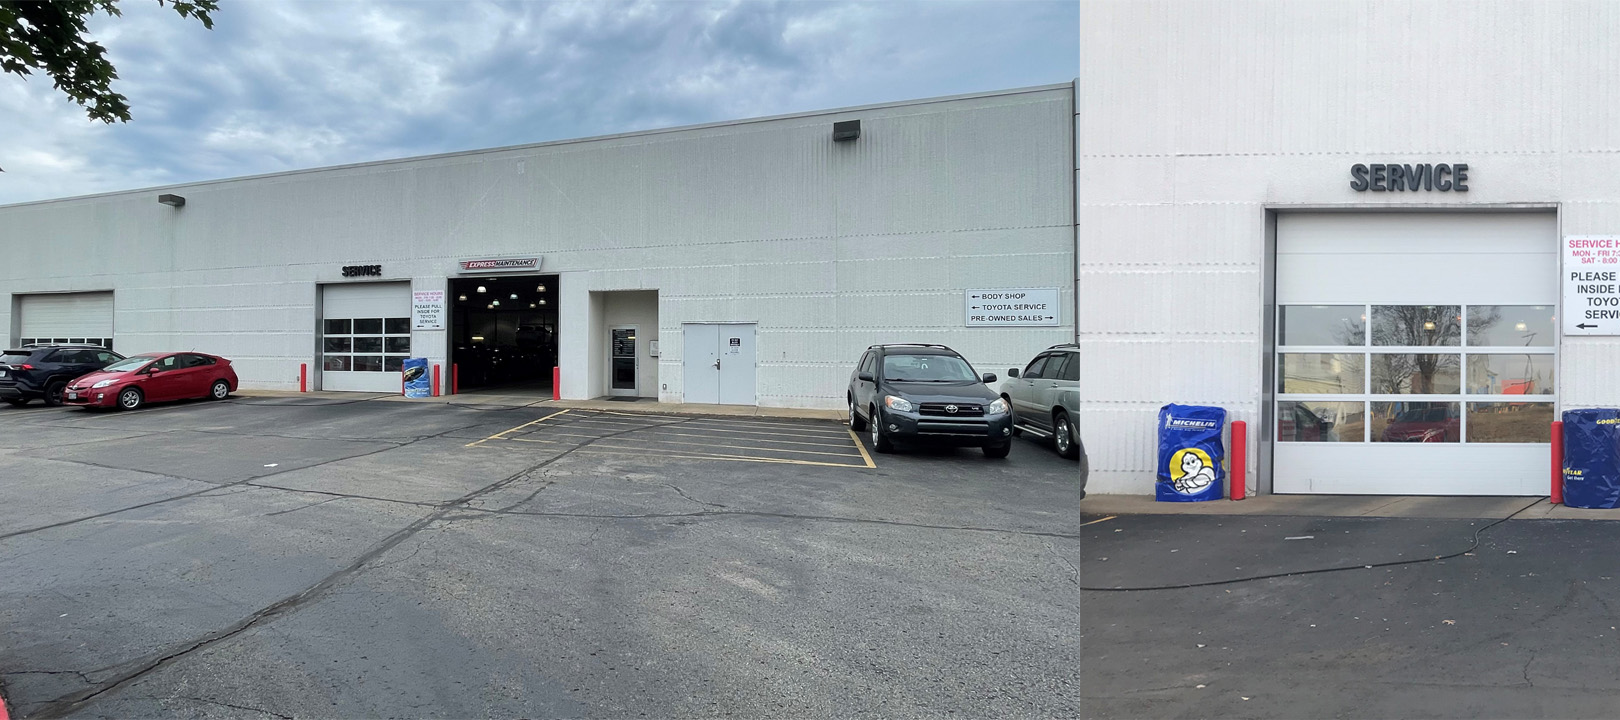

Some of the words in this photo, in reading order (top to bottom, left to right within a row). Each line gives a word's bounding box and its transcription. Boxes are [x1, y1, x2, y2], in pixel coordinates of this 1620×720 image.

[1350, 163, 1469, 192] SERVICE
[1568, 239, 1613, 248] SERVICE
[495, 259, 535, 267] MAINTENANCE
[342, 265, 382, 278] SERVICE
[1571, 272, 1617, 281] PLEASE
[1577, 284, 1615, 294] INSIDE
[1172, 419, 1216, 427] MICHELIN
